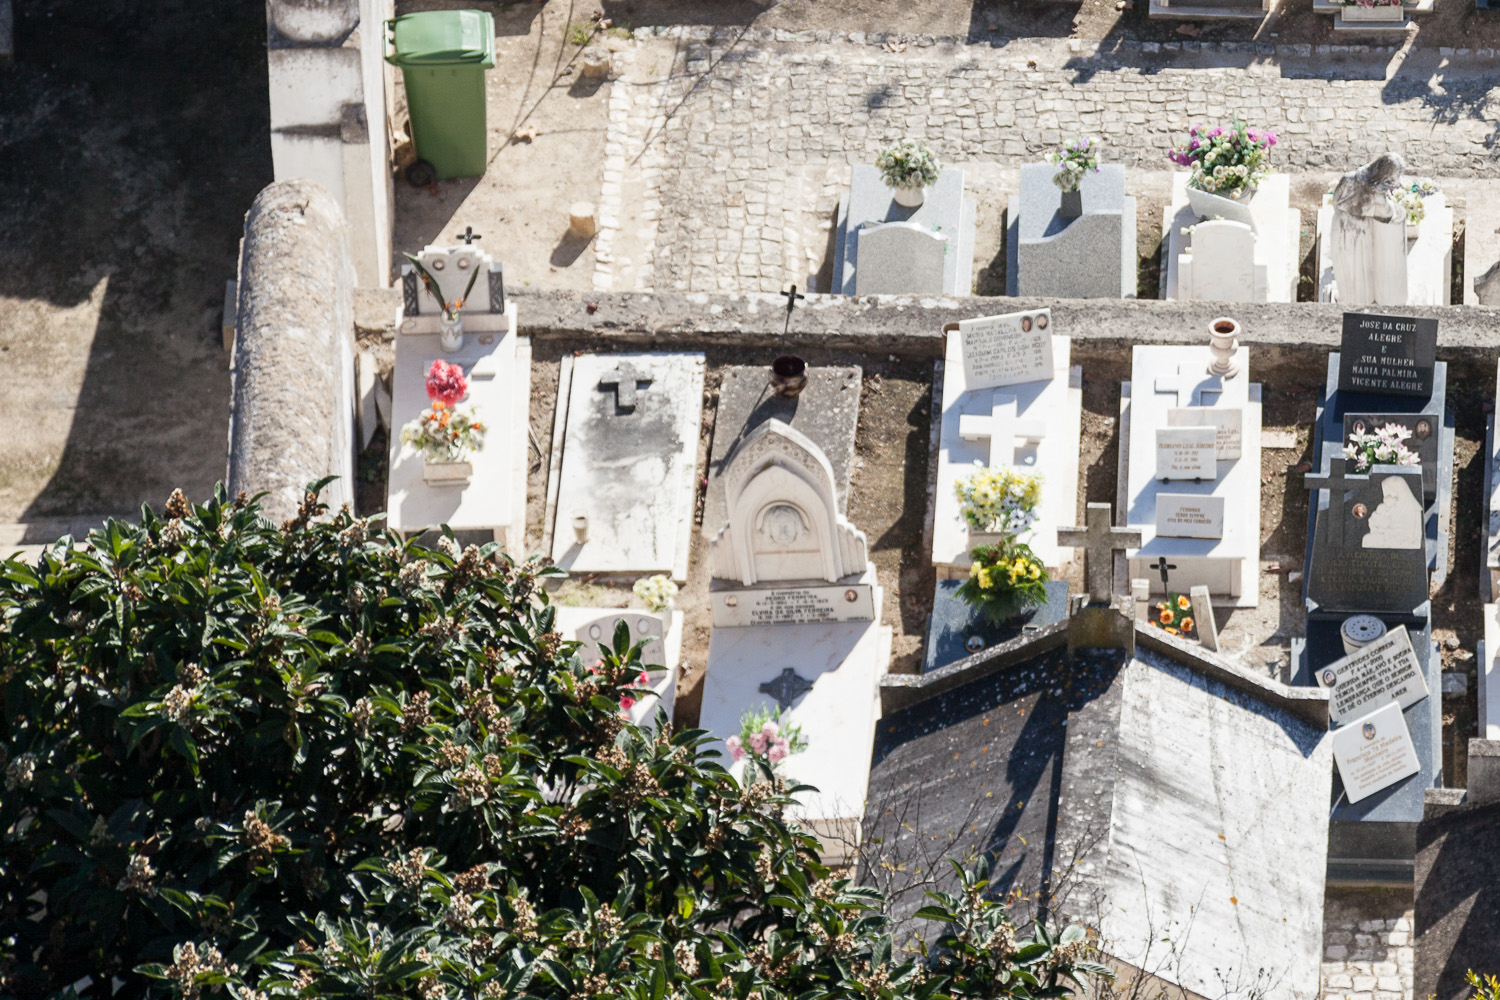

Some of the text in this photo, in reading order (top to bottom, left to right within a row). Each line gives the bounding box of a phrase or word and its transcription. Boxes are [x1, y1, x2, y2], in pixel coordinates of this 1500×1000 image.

[1382, 322, 1393, 331] DA
[1395, 323, 1417, 333] CRUZ
[1368, 333, 1402, 343] ALEGRE
[1381, 345, 1387, 353] E
[1360, 355, 1414, 367] SUA MULHER
[1352, 366, 1418, 379] MARIA PALMIRA
[1352, 377, 1423, 392] VICENTE ALEGRE
[1336, 640, 1395, 675] GERTRUDES CORREIA
[1335, 676, 1359, 692] QUERIDA
[1393, 648, 1412, 661] SOGRA
[1334, 686, 1354, 700] TEMOS
[1355, 674, 1377, 689] SEMPRE
[1378, 667, 1392, 677] VIVA
[1398, 657, 1409, 666] TUA
[1336, 687, 1371, 709] LEMBRANÇA
[1371, 679, 1384, 690] QUE
[1391, 664, 1412, 678] SENHOR
[1391, 686, 1407, 700] AMEN
[1338, 708, 1347, 716] TE
[1362, 687, 1385, 703] ETERNO
[1346, 750, 1371, 765] Francisco
[1380, 735, 1402, 747] Madeira
[1364, 748, 1389, 762] Monteiro
